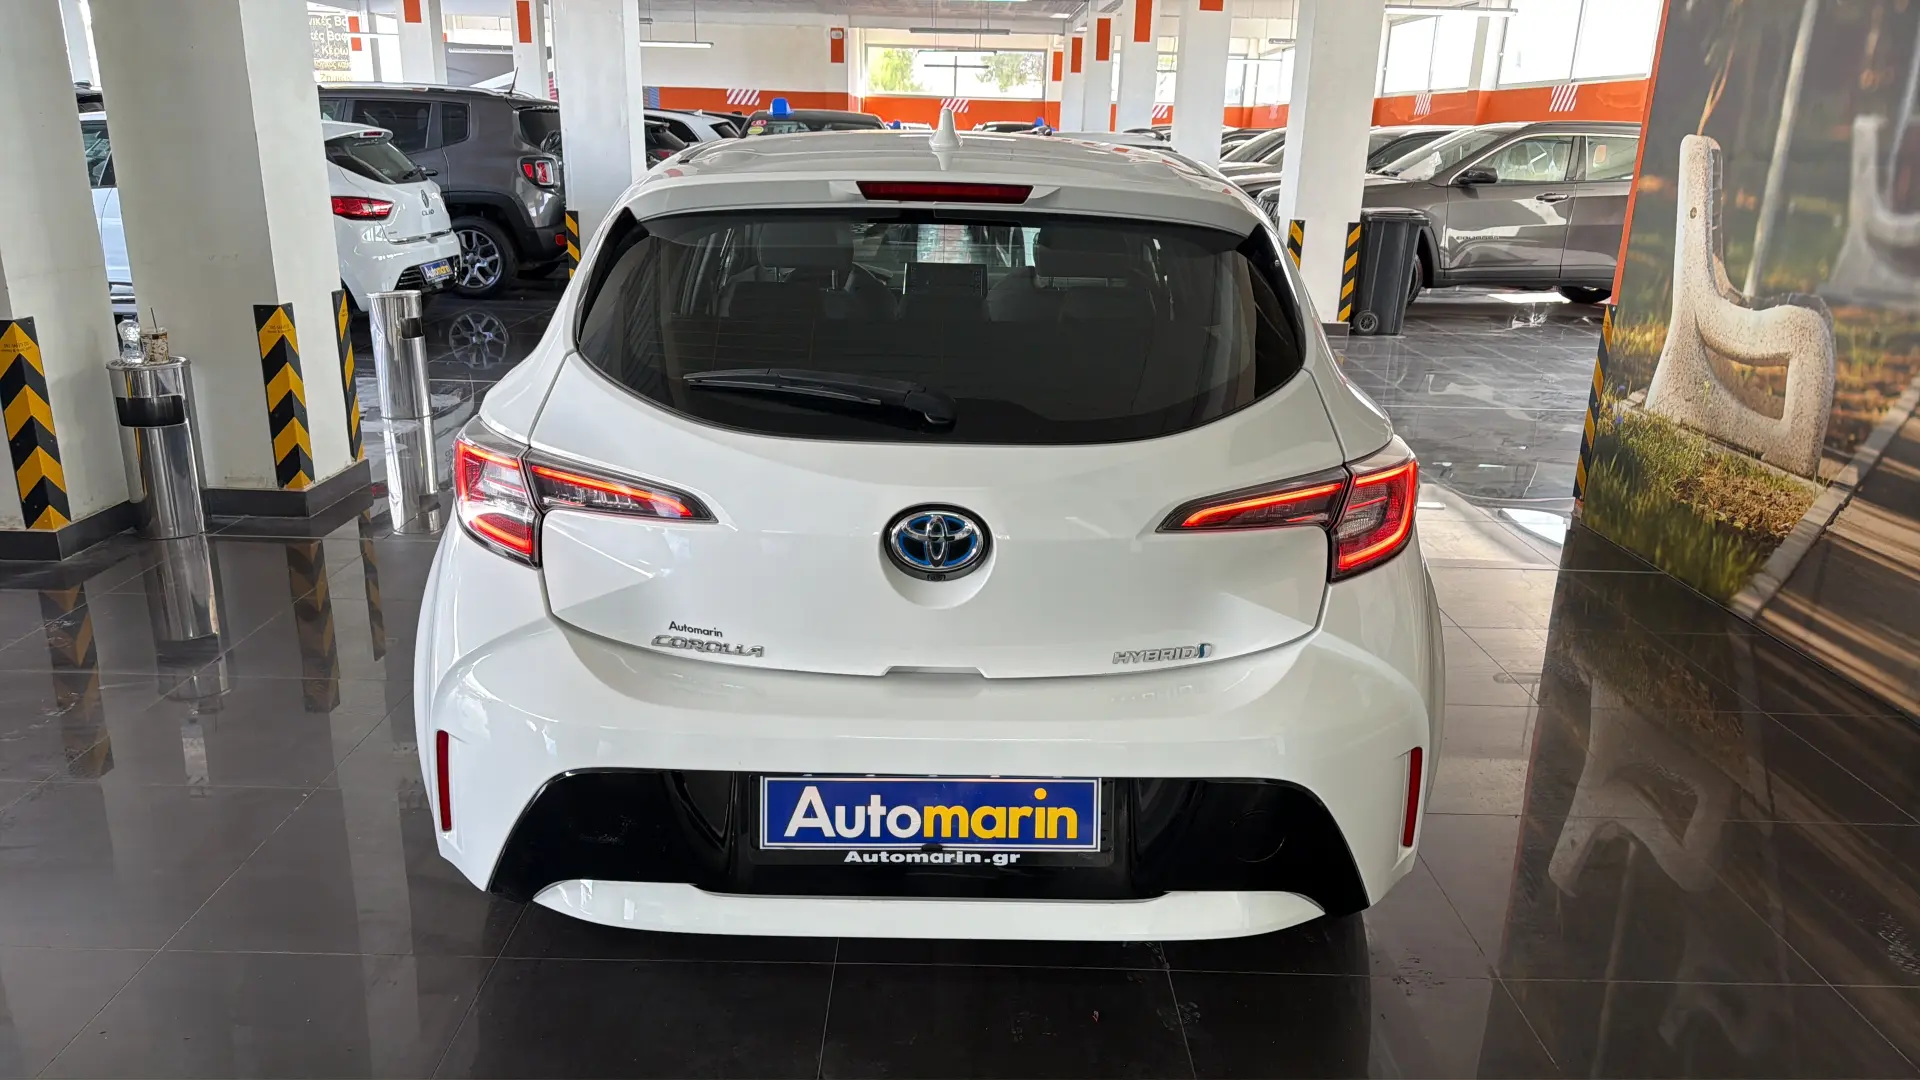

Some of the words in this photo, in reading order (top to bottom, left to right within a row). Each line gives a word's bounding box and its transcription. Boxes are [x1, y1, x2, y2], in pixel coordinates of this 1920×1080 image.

[668, 620, 723, 638] Automarin
[651, 634, 765, 658] COROLLA
[1112, 645, 1197, 664] HYBRID
[784, 786, 1078, 839] Automarin
[843, 851, 1021, 866] Automarin.gr
